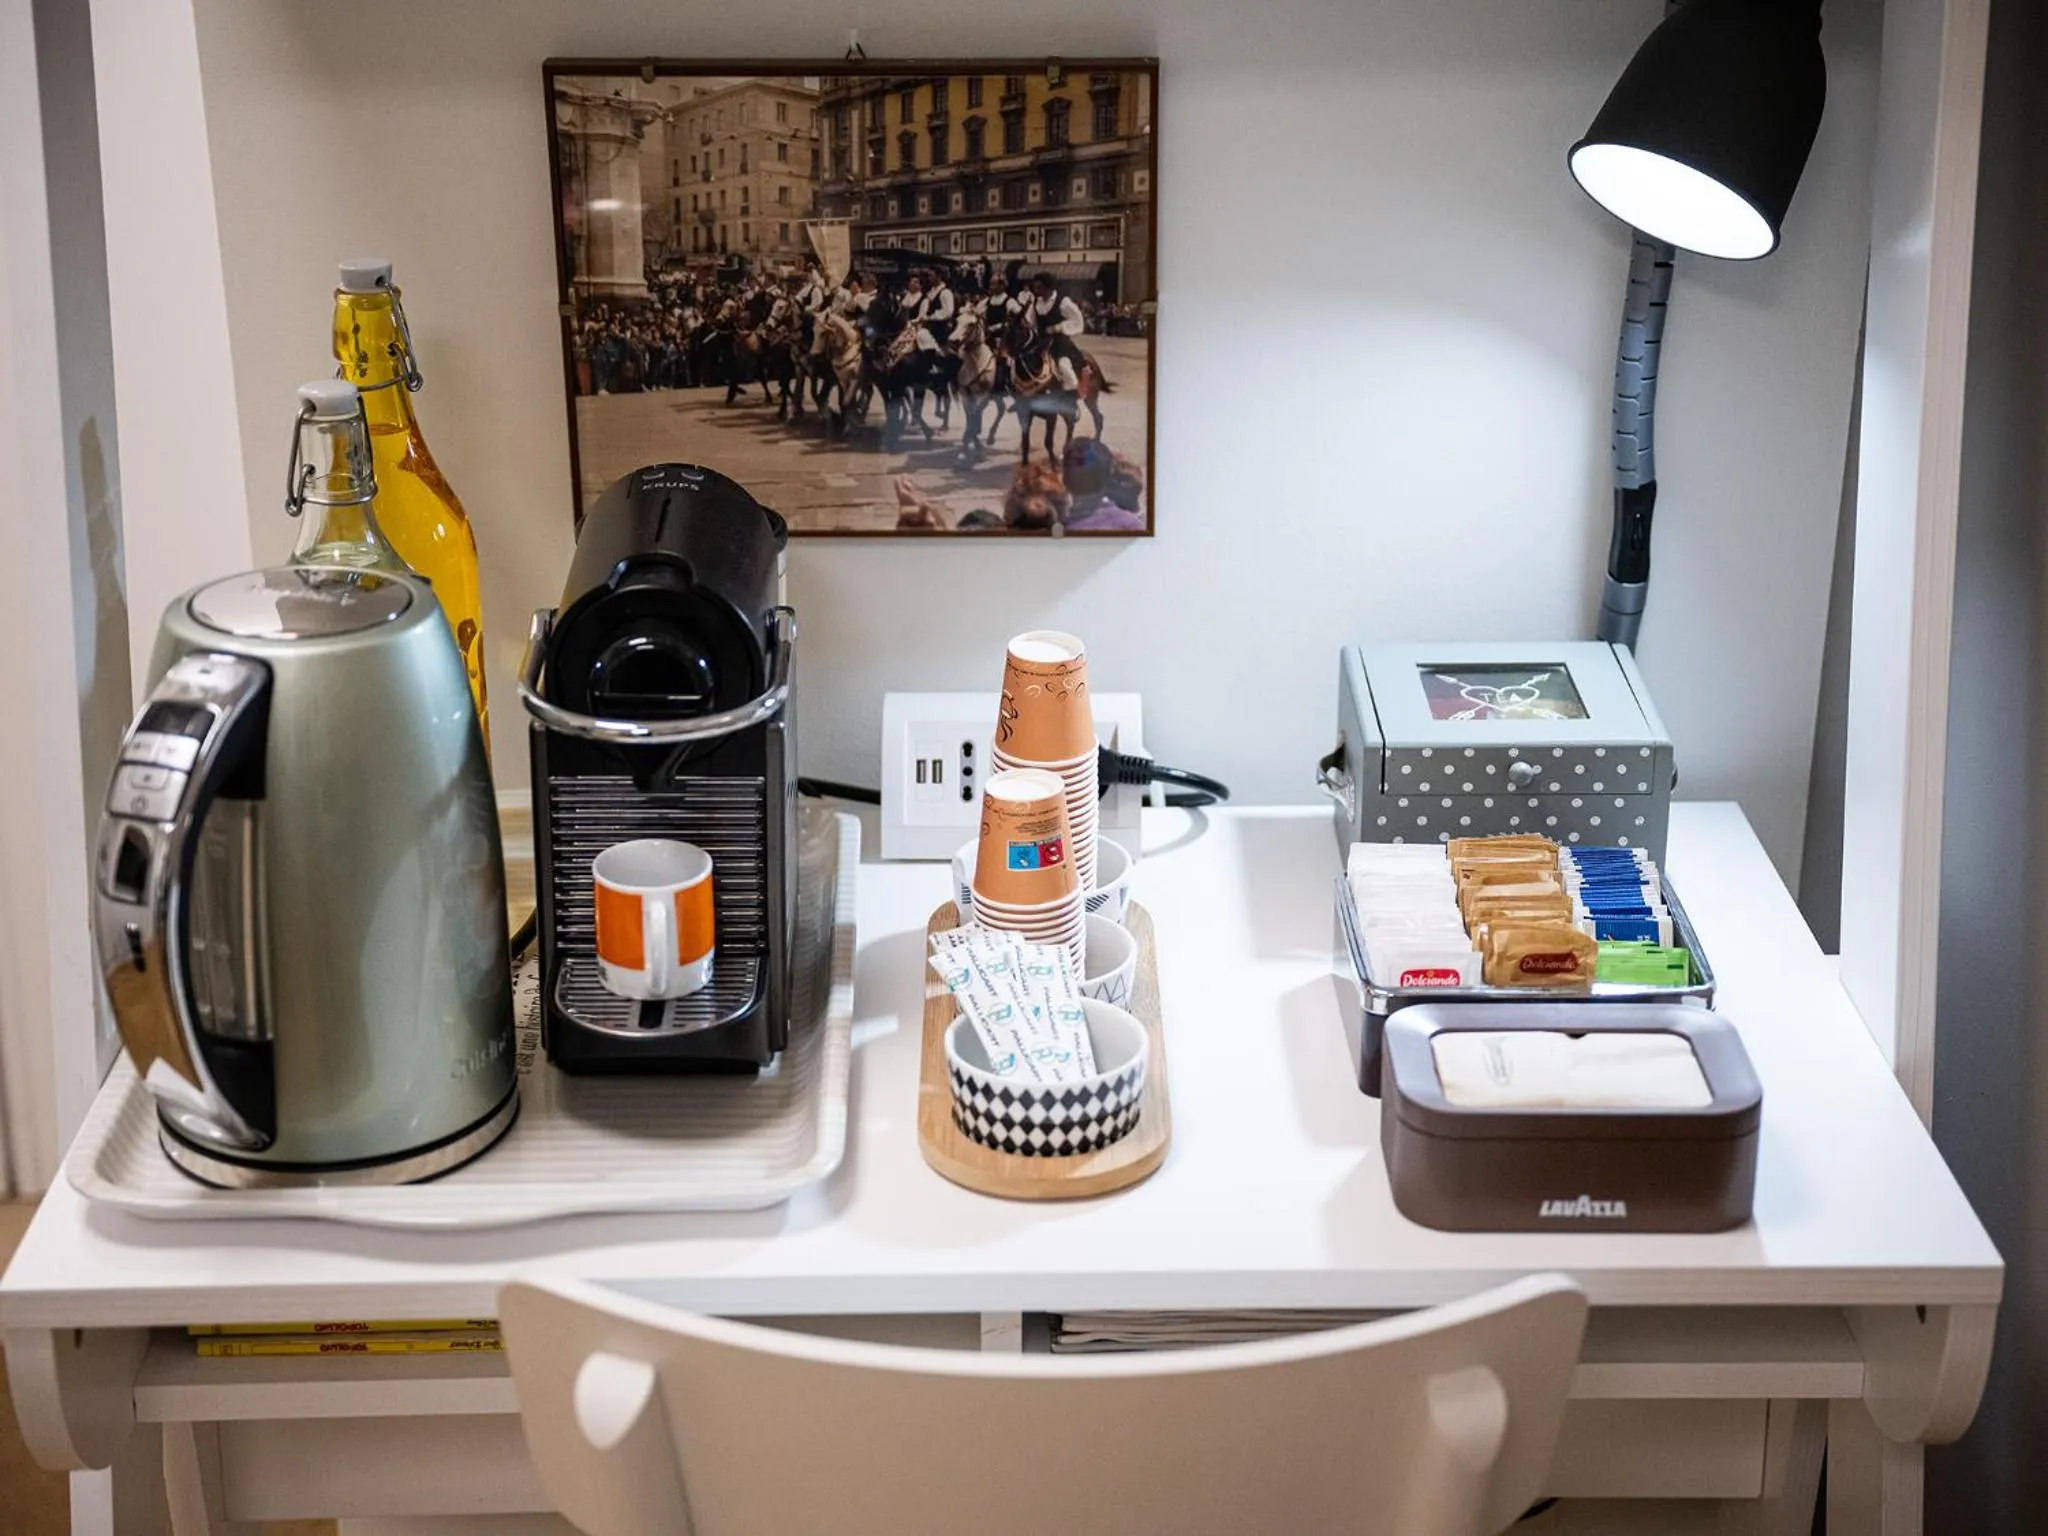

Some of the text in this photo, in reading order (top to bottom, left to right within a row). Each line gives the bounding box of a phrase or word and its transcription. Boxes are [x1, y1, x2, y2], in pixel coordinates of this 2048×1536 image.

[642, 481, 700, 491] KRUPS
[1402, 973, 1459, 987] Dolciando
[1539, 1194, 1627, 1217] LAVAZZA
